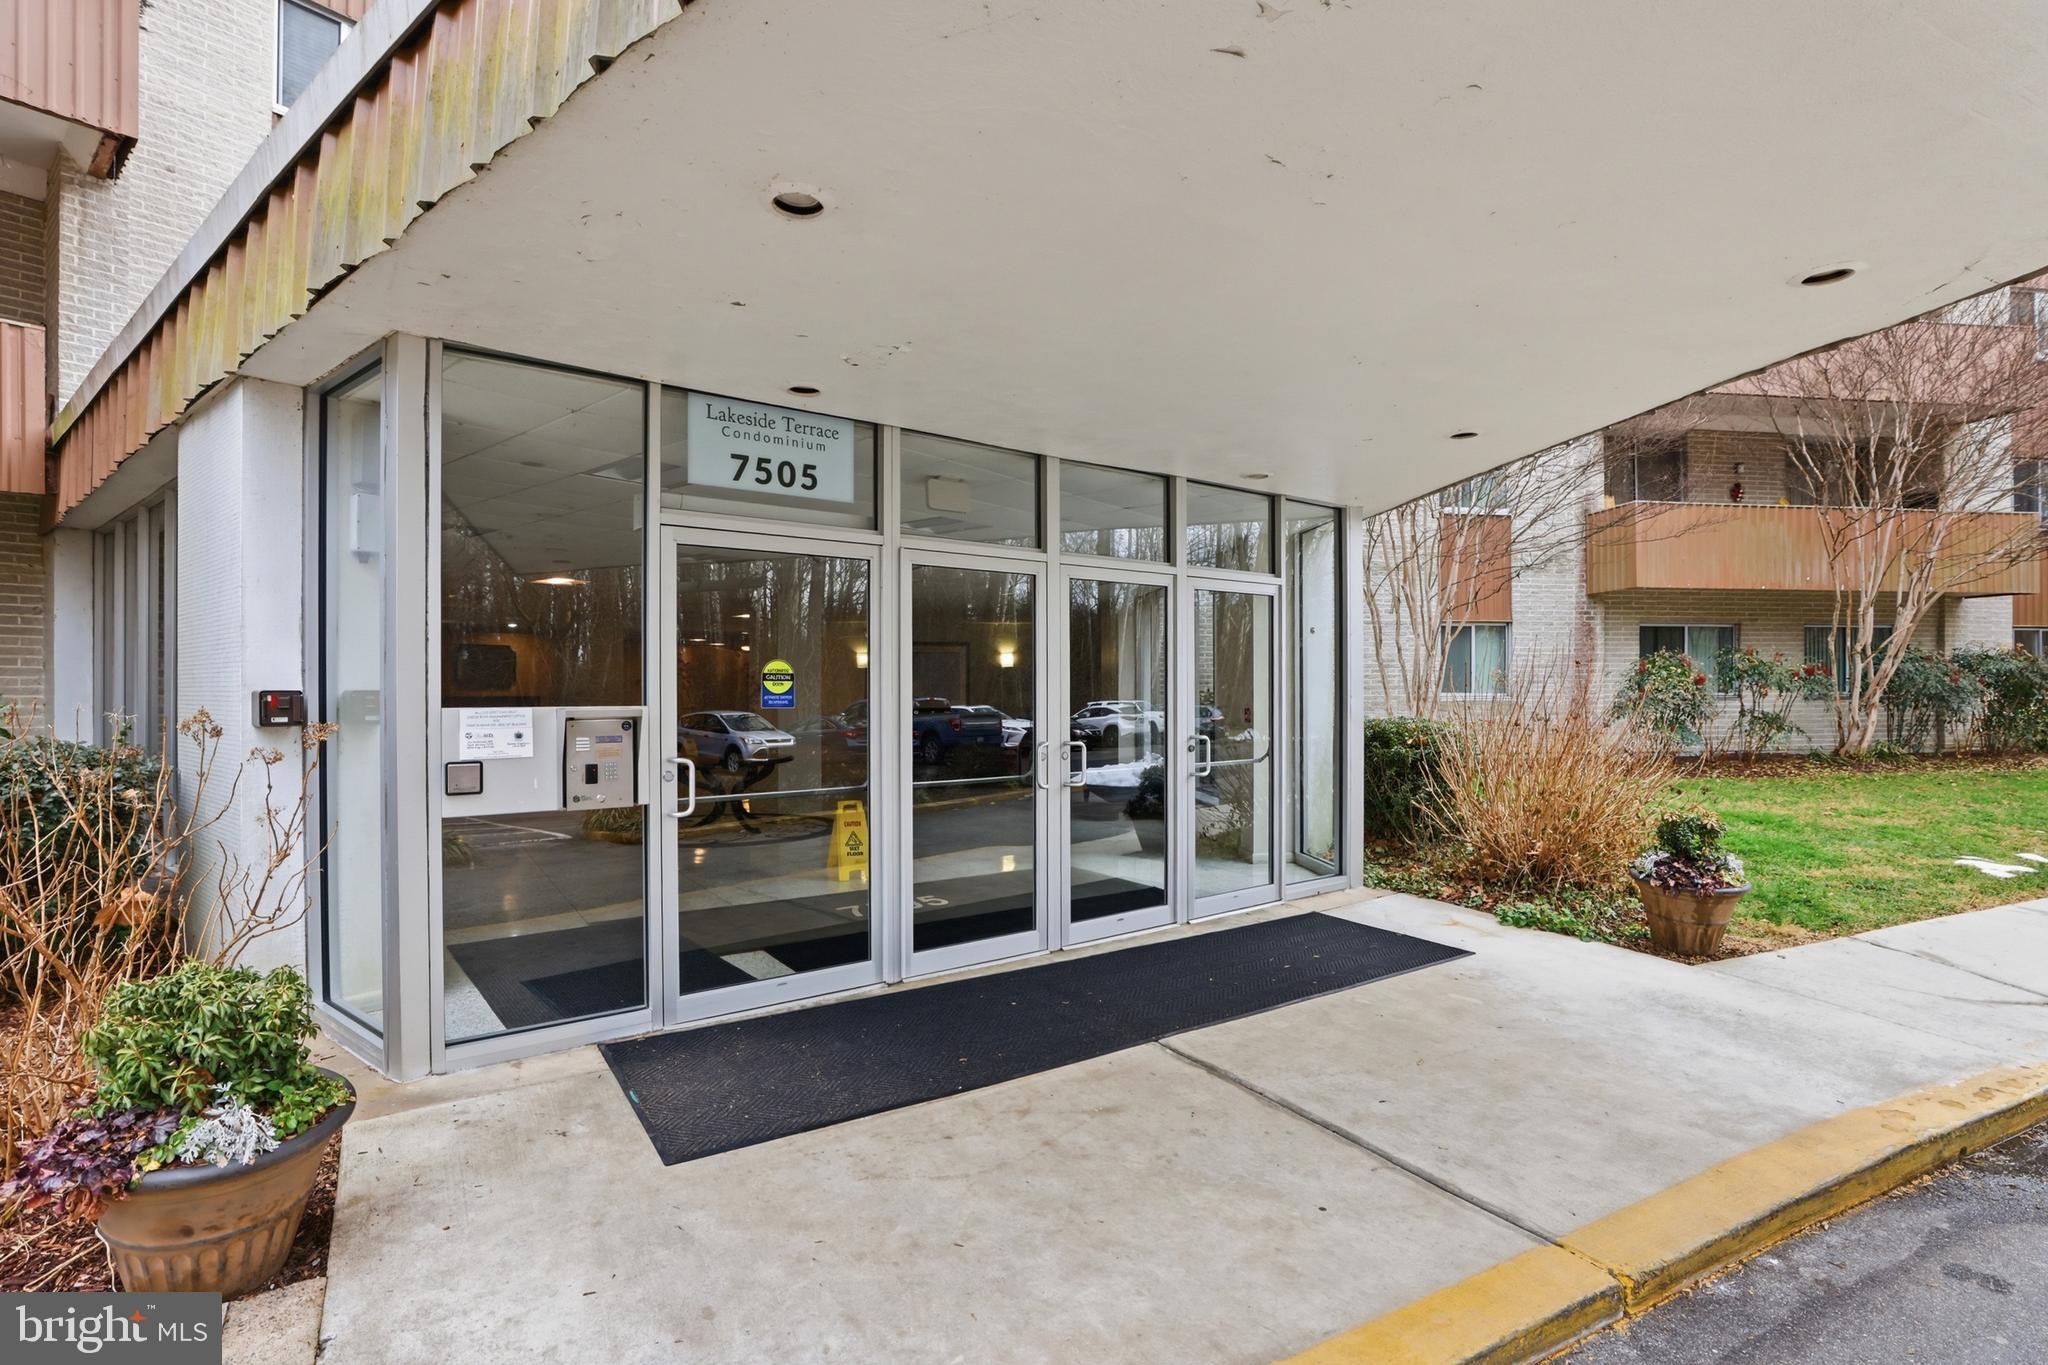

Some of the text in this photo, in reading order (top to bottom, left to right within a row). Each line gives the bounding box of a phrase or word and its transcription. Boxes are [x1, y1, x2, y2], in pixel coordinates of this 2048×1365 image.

[706, 403, 840, 440] Lakeside Terrace
[721, 426, 826, 452] Condominium
[730, 453, 818, 491] 7505
[844, 820, 862, 828] CAUTION
